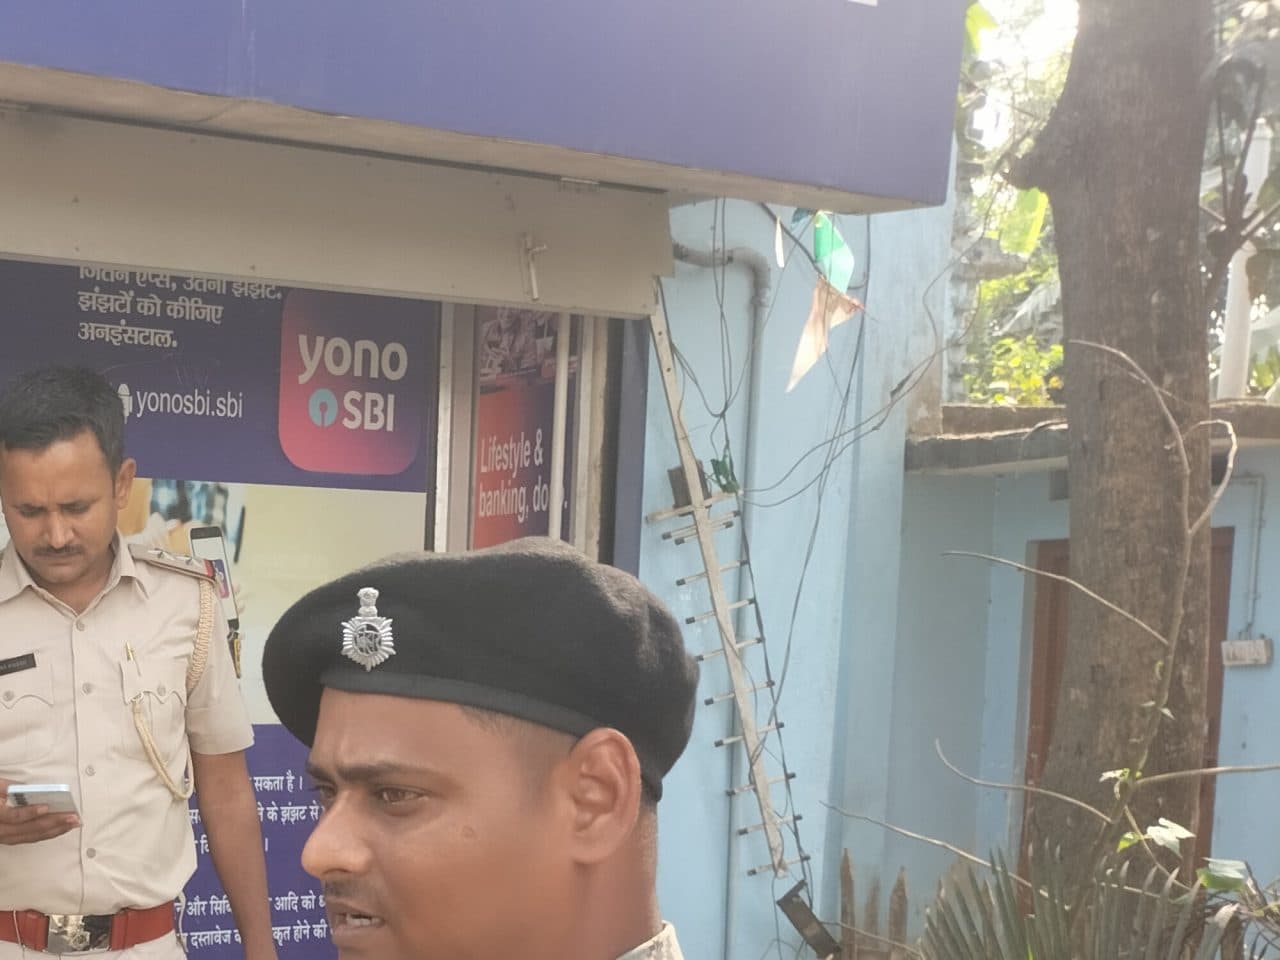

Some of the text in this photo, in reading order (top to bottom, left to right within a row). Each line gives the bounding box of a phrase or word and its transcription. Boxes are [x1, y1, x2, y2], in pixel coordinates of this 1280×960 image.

[136, 293, 162, 317] को
[166, 297, 224, 324] कीजिए
[298, 333, 408, 384] yono
[342, 391, 395, 432] SBI
[480, 428, 544, 478] Lifestyle &
[253, 775, 284, 792] सकता
[266, 800, 278, 822] के
[280, 802, 308, 825] झंझट
[309, 799, 320, 821] से
[187, 896, 207, 916] और
[274, 891, 299, 912] आदि
[301, 890, 316, 911] को
[190, 925, 232, 950] दस्तावेज
[293, 919, 311, 943] होने
[312, 918, 328, 940] की
